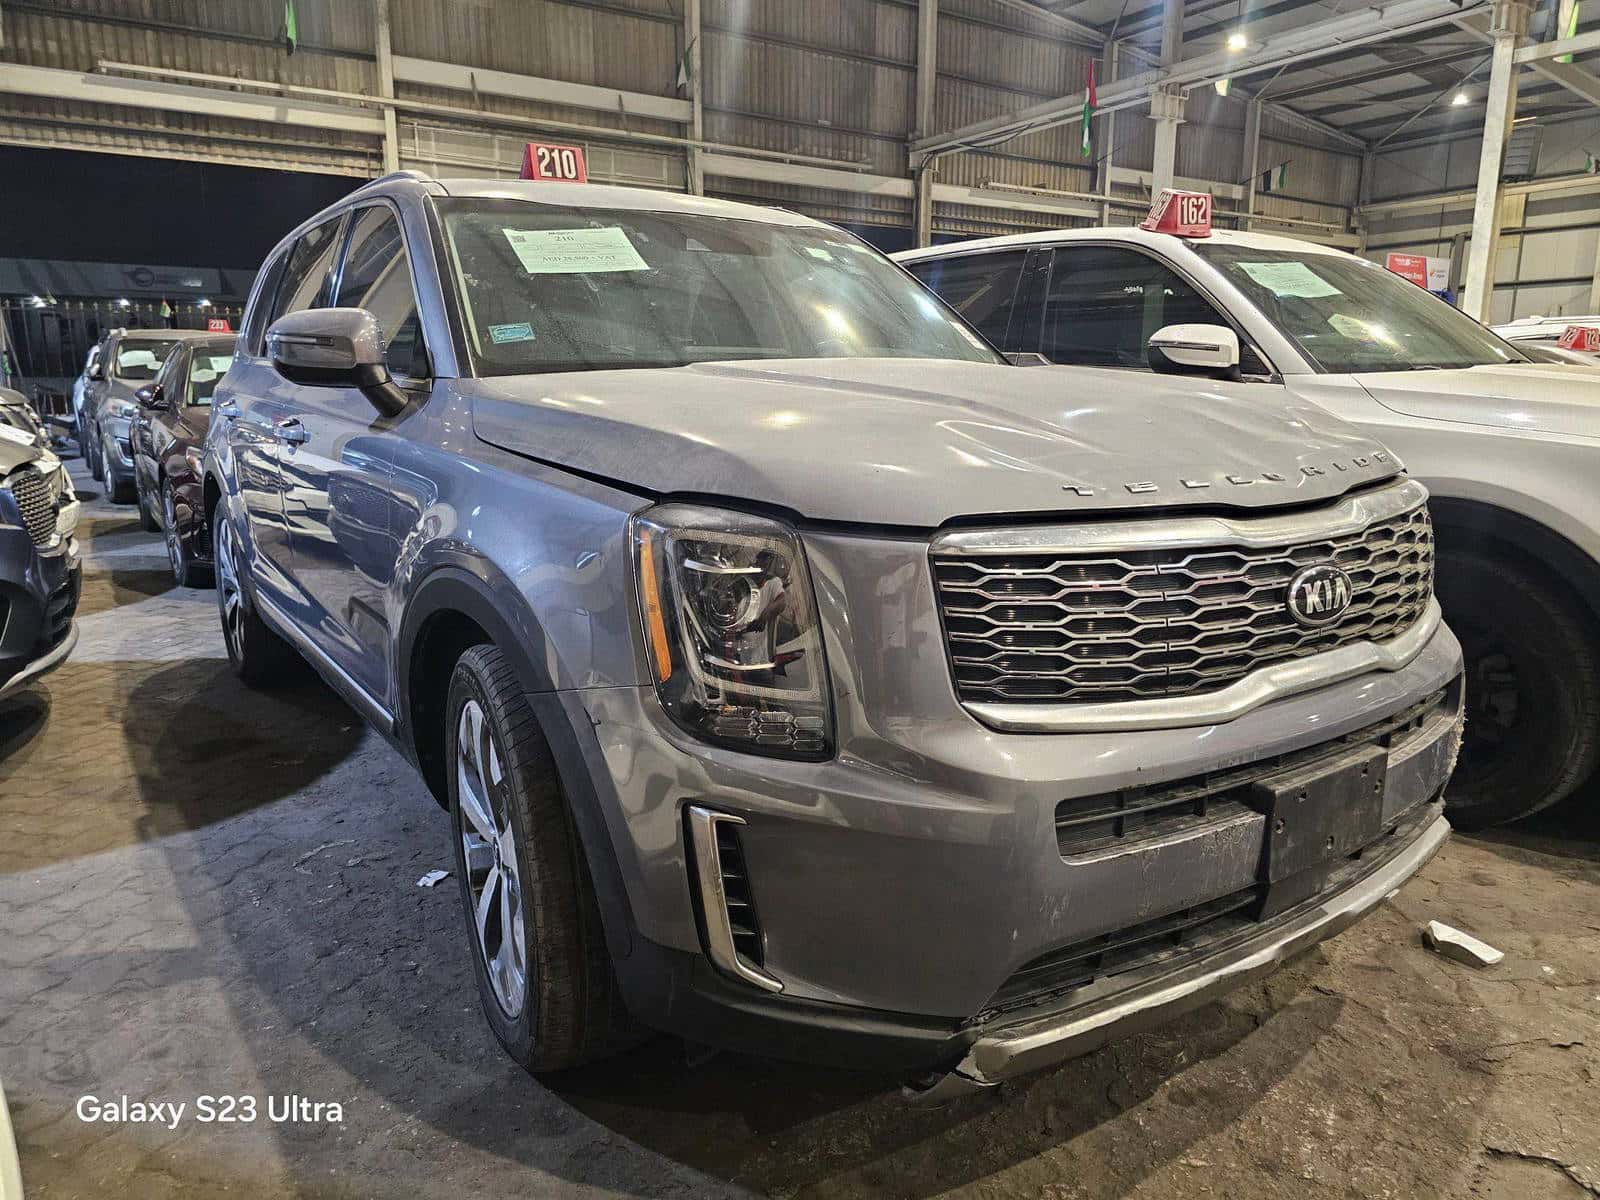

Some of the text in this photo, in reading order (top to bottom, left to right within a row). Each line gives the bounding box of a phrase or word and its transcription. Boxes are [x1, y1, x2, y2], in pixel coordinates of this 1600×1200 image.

[537, 147, 576, 179] 210
[1182, 197, 1208, 225] 162
[1062, 451, 1390, 496] TELLURIDE
[1304, 578, 1349, 614] KIA
